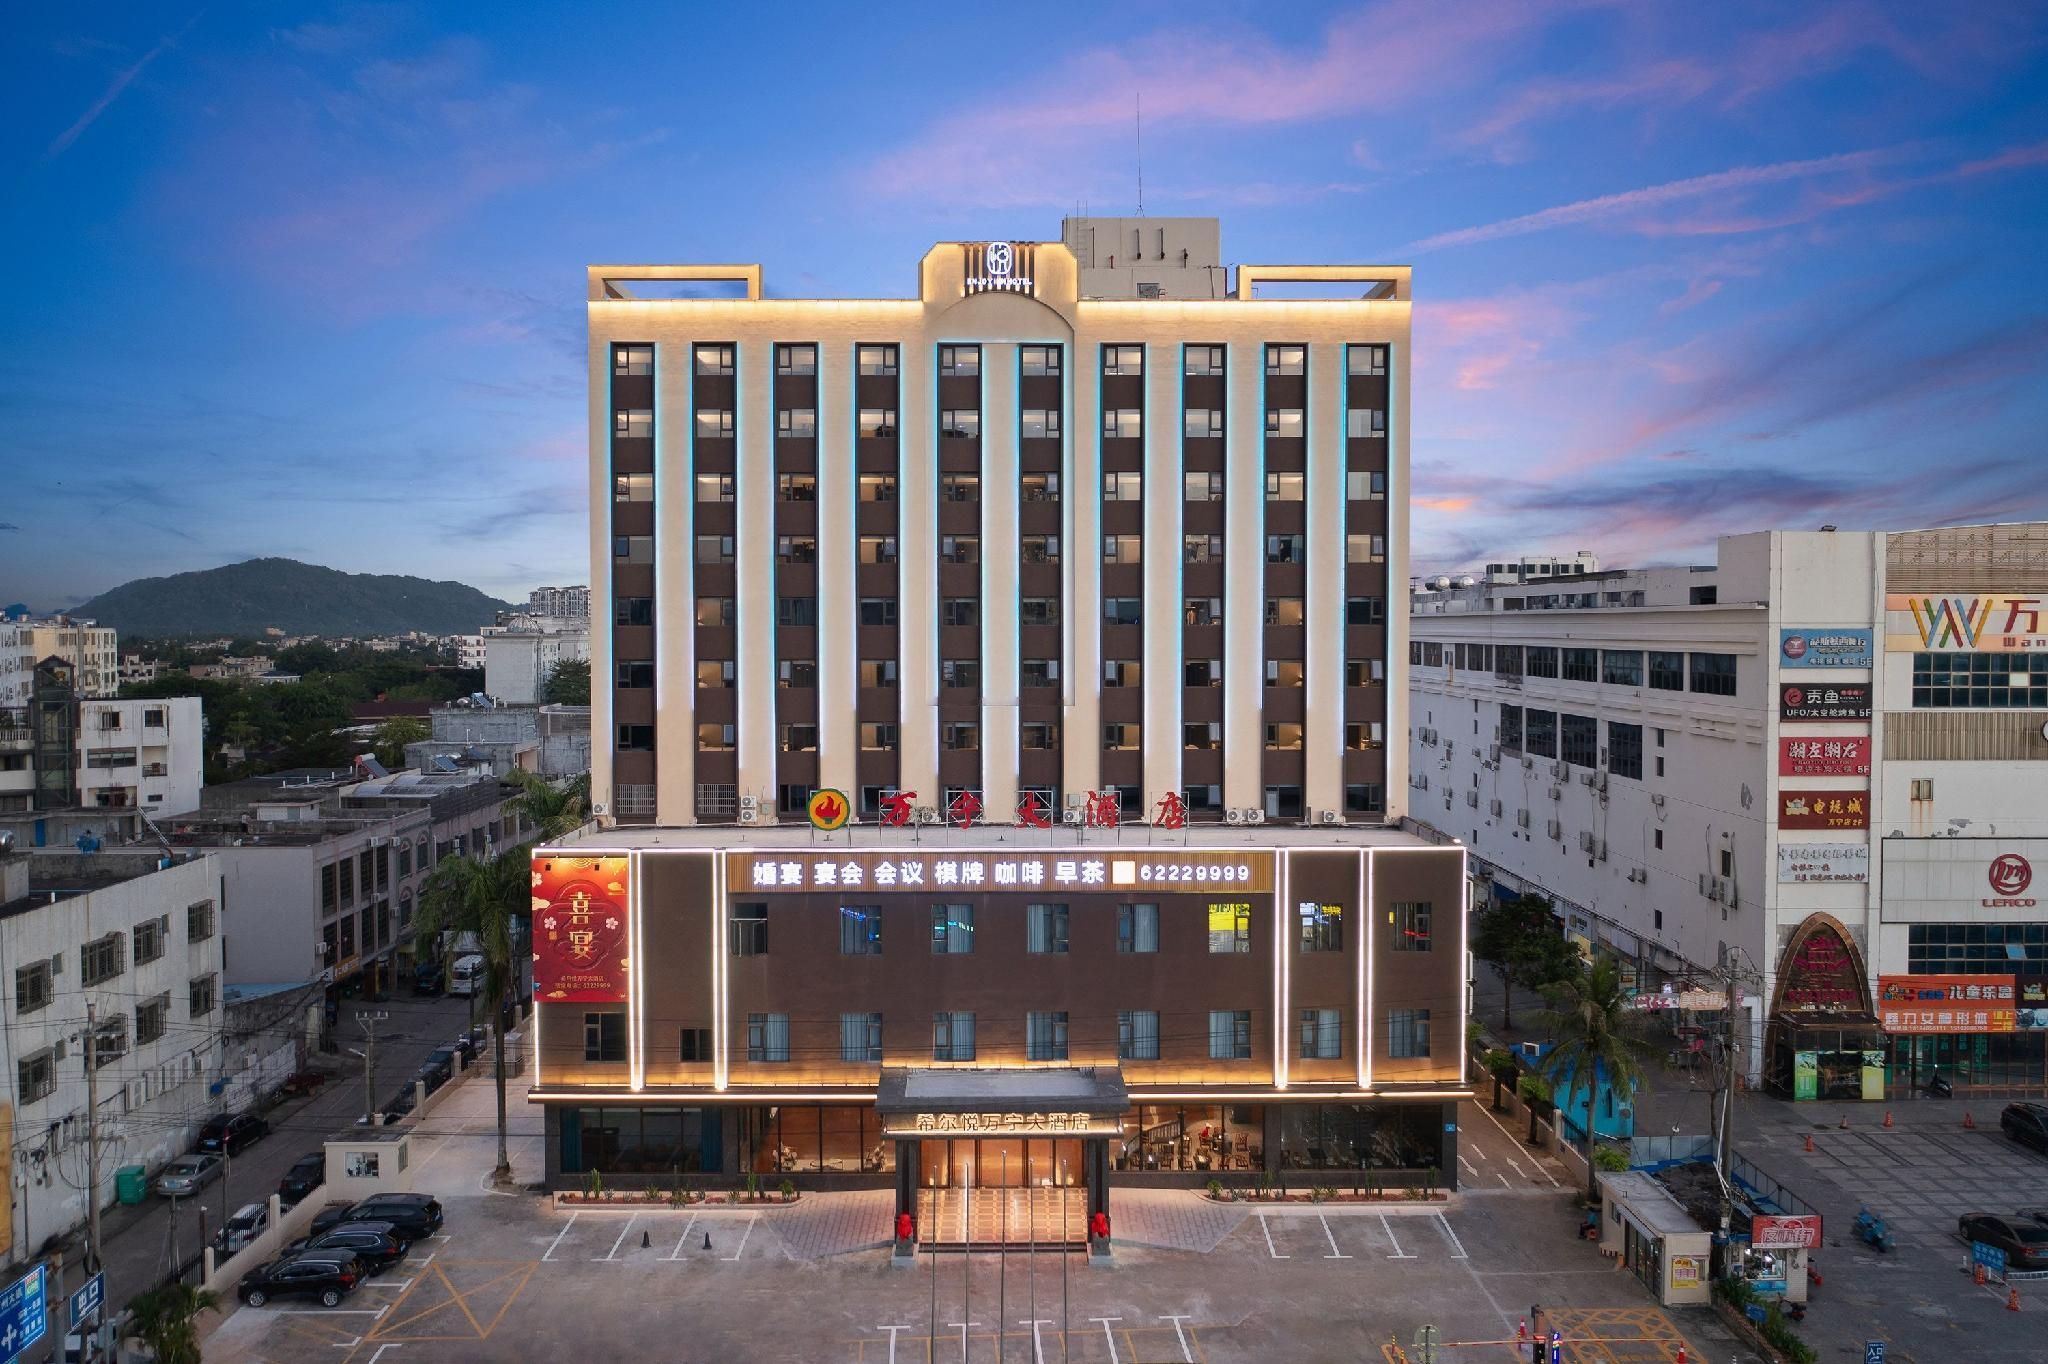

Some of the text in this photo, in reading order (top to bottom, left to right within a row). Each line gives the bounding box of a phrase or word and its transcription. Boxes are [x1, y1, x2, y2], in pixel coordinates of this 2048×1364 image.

[2003, 599, 2041, 633] 万
[1806, 689, 1840, 704] 贡鱼
[1788, 742, 1857, 759] 潮左潮右
[753, 861, 1249, 885] 婚宴 宴会 会议 棋牌 咖啡 早茶 62229999
[1949, 985, 2013, 1001] 儿童乐园
[916, 1113, 1090, 1132] 希尔悦万宁大酒店
[78, 1280, 99, 1310] 出口
[1867, 1347, 1883, 1357] 入口
